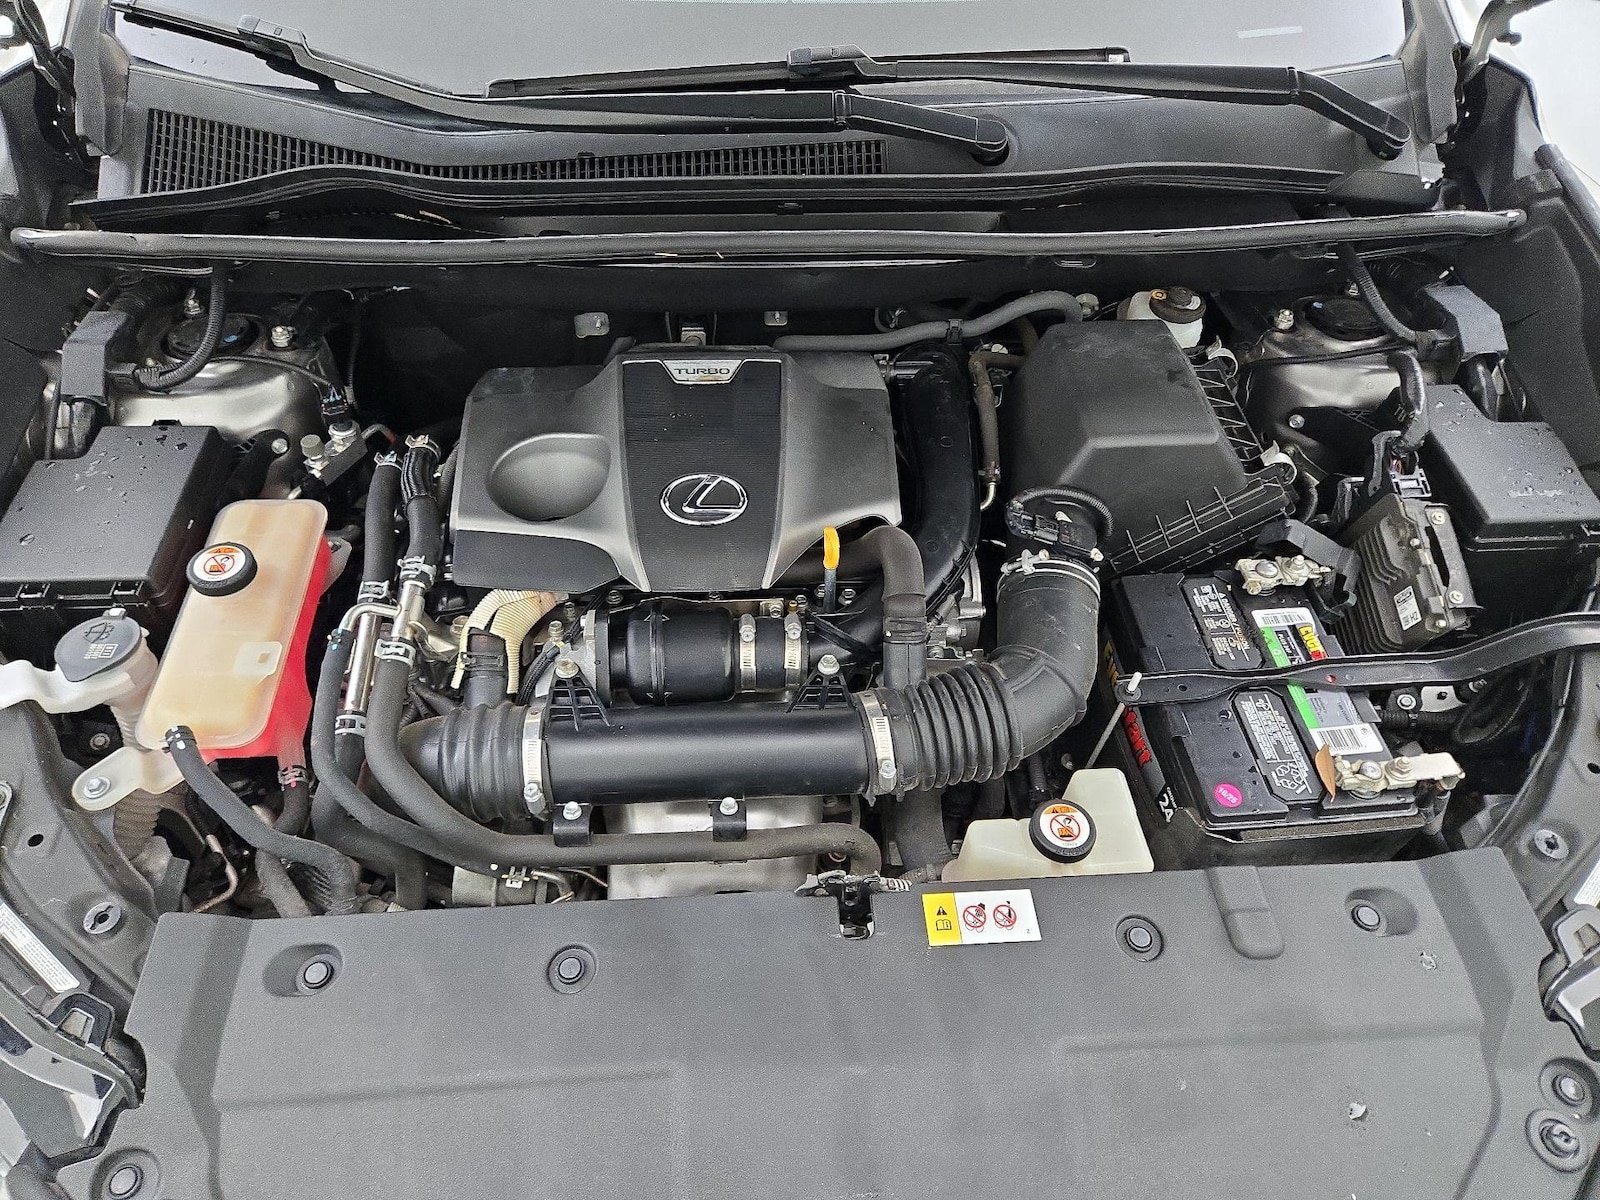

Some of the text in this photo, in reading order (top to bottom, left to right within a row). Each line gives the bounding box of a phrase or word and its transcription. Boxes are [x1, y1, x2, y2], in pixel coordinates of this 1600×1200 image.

[674, 367, 731, 375] TURBO
[1218, 787, 1239, 804] 10/25
[1158, 793, 1174, 823] 24
